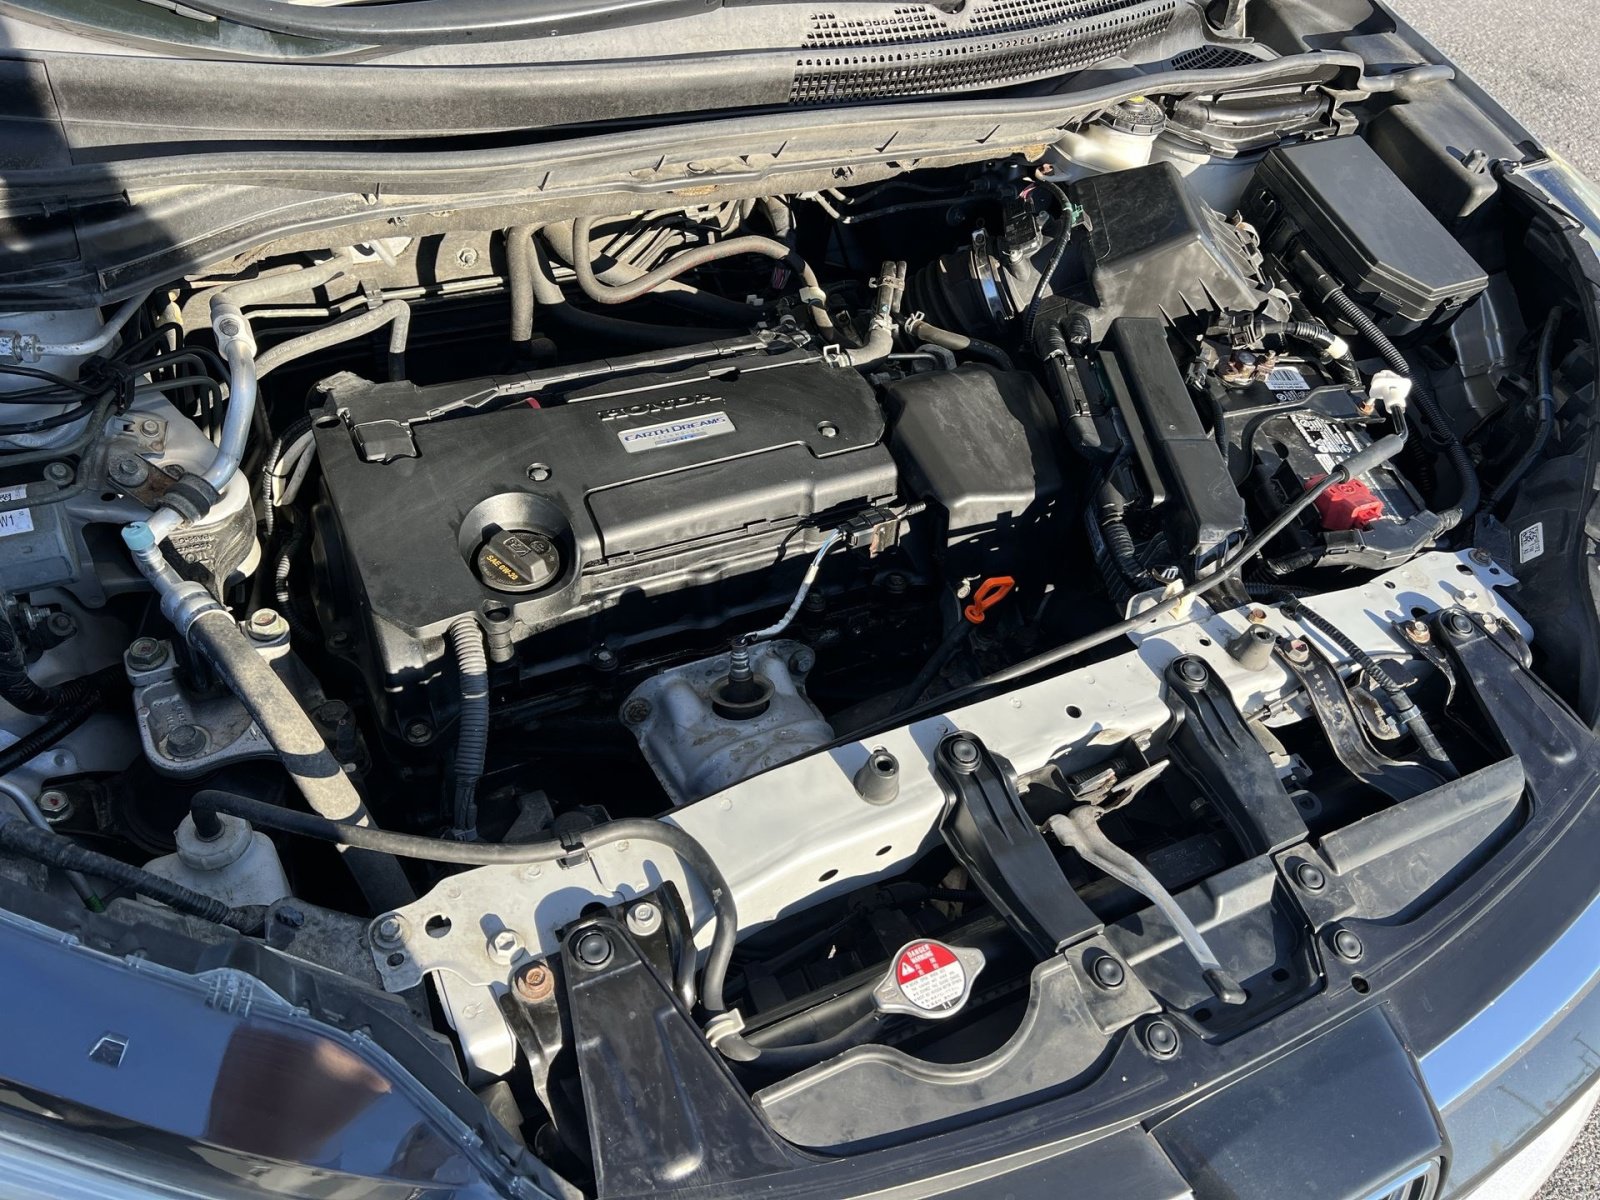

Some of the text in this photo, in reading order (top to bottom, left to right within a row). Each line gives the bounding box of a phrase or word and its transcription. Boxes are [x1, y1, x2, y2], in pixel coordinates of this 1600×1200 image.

[596, 393, 723, 421] HONDA
[624, 427, 670, 442] EARTH
[671, 418, 726, 432] DREAMS
[486, 555, 501, 568] SAE
[499, 564, 519, 580] 0W-20
[906, 944, 931, 958] DANGER
